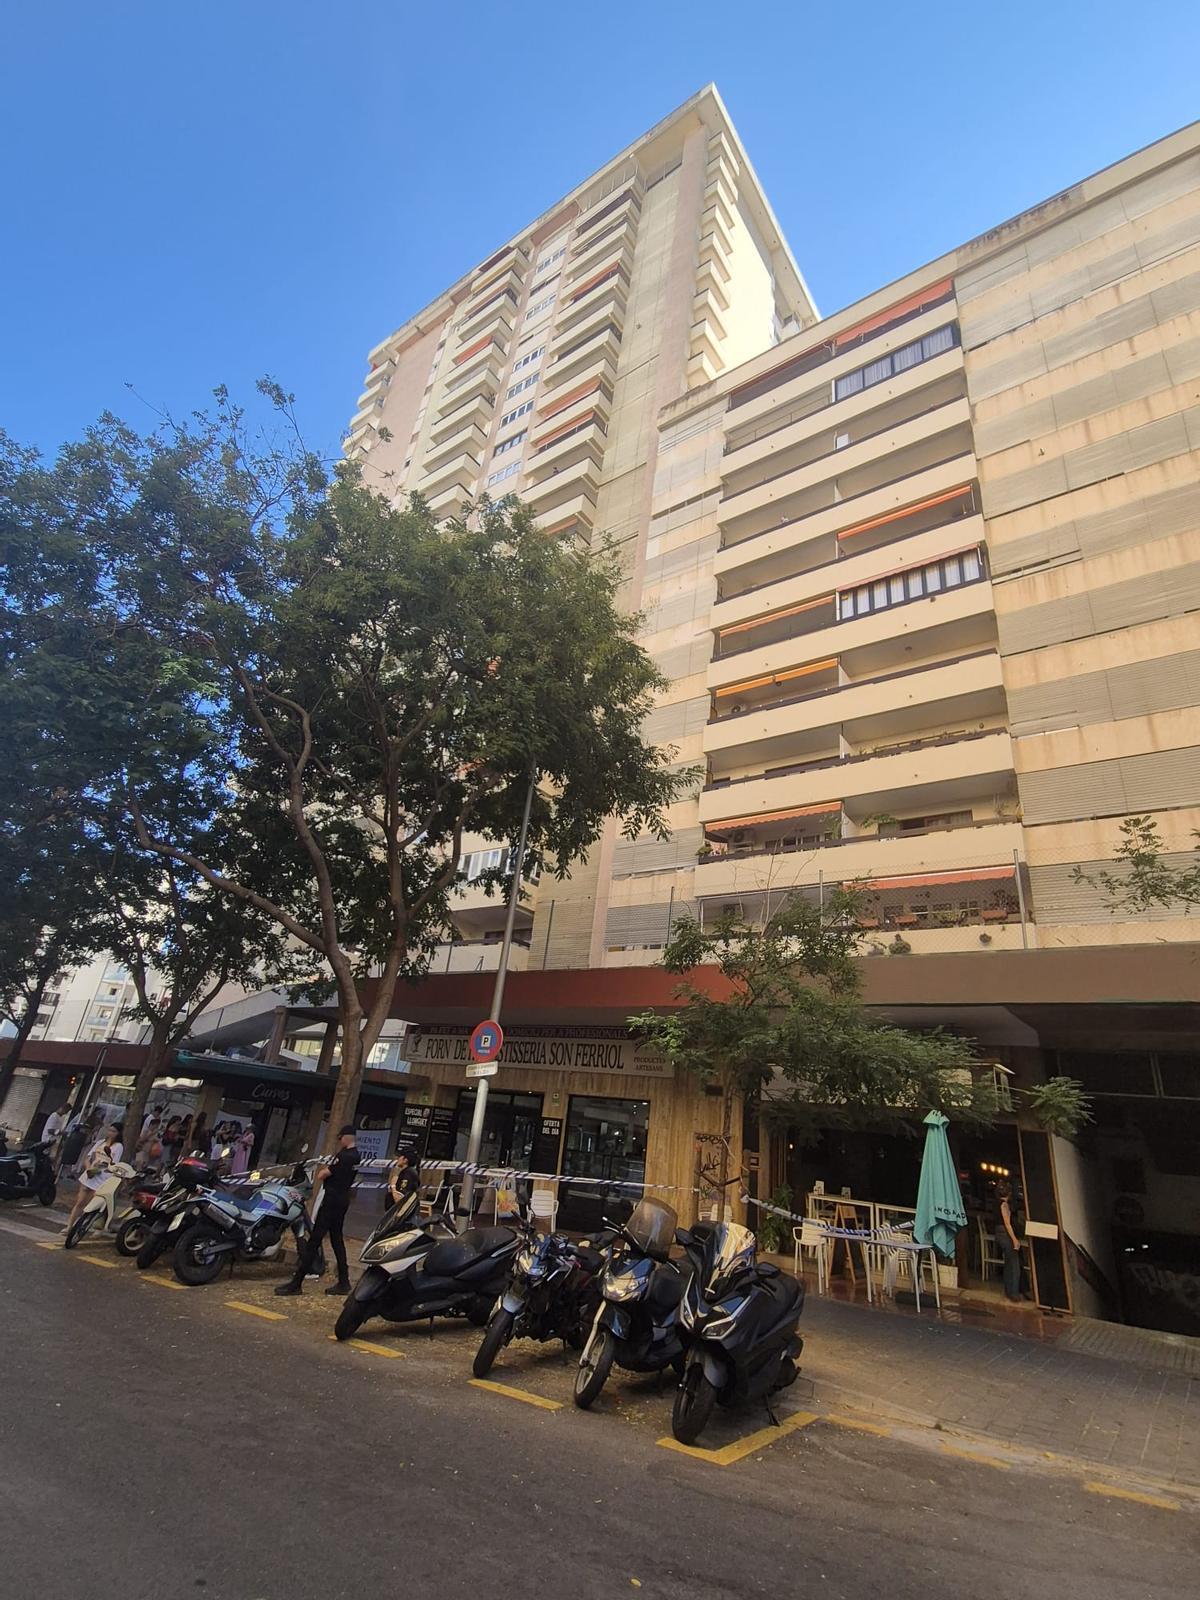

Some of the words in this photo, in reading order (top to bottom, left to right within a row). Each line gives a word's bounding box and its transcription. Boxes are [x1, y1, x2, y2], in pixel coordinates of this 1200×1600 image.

[483, 1037, 489, 1046] P
[425, 1039, 452, 1059] FORN
[549, 1042, 573, 1065] SON
[575, 1044, 624, 1069] FERRIOL
[252, 1083, 289, 1100] Curves
